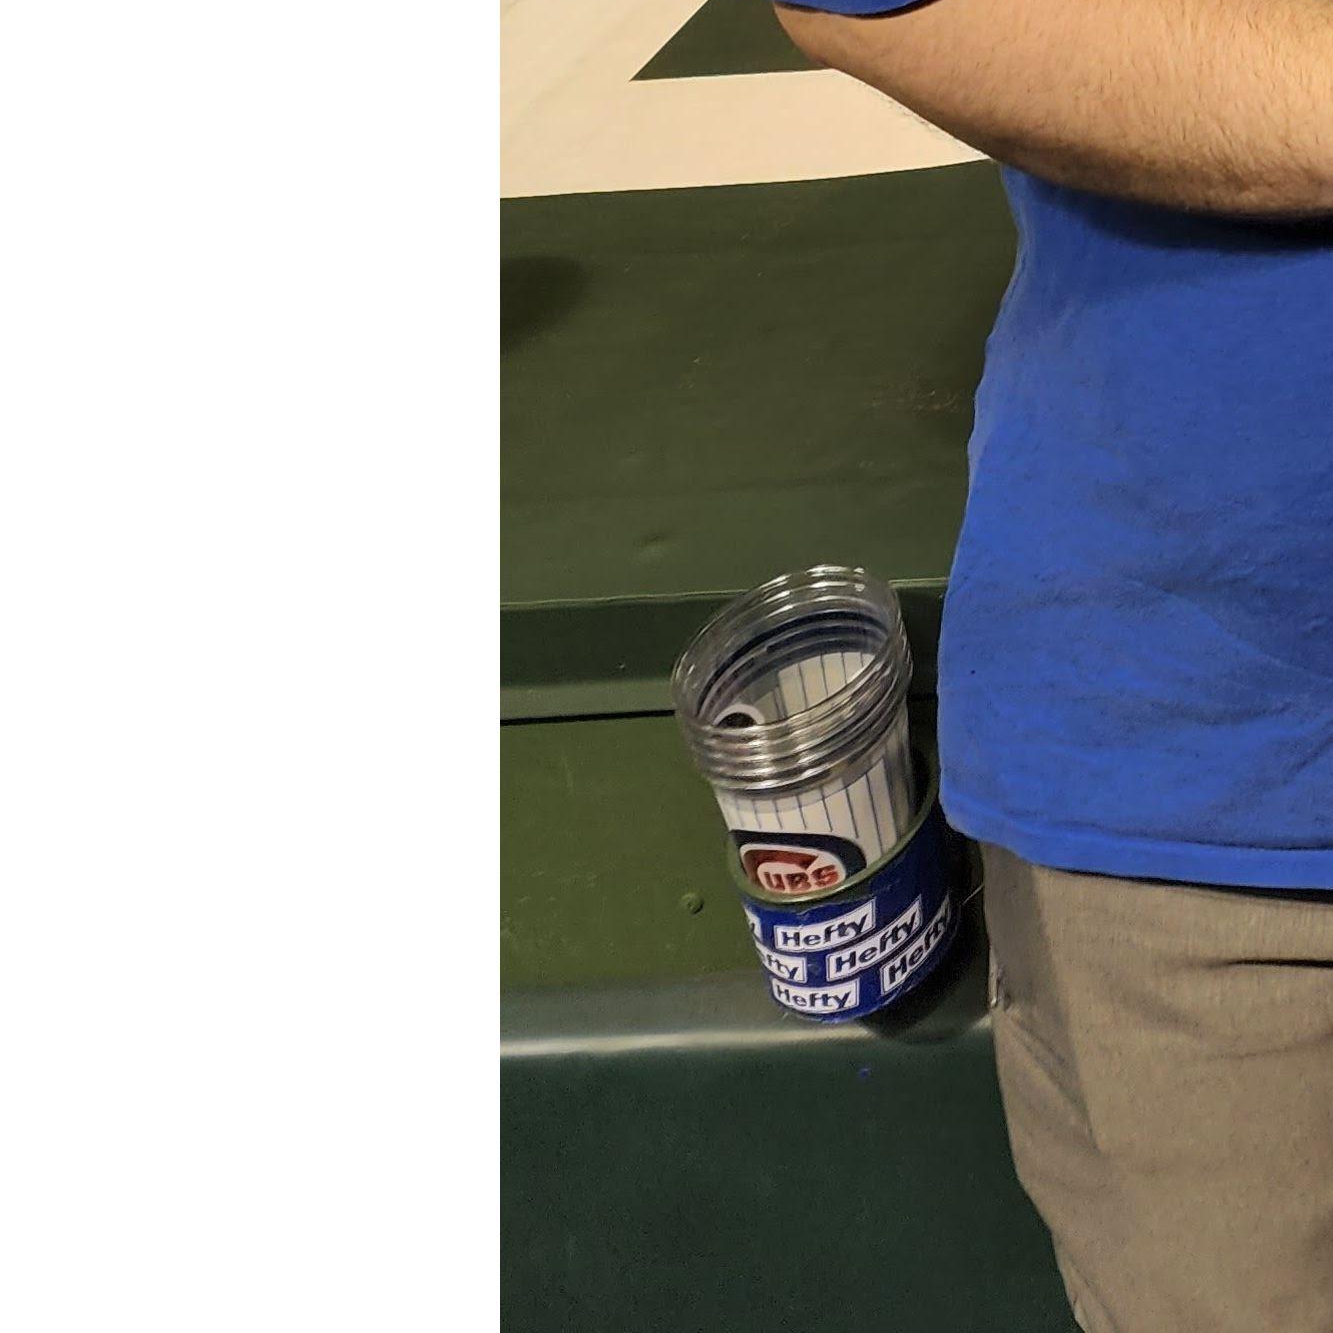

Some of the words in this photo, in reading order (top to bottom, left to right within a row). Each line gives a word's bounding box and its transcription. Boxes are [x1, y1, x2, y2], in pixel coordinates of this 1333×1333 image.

[781, 913, 868, 947] Hefty
[835, 911, 917, 973] Hefty
[760, 953, 799, 980] fty
[888, 917, 948, 985] Heft
[775, 984, 852, 1009] Hefty
